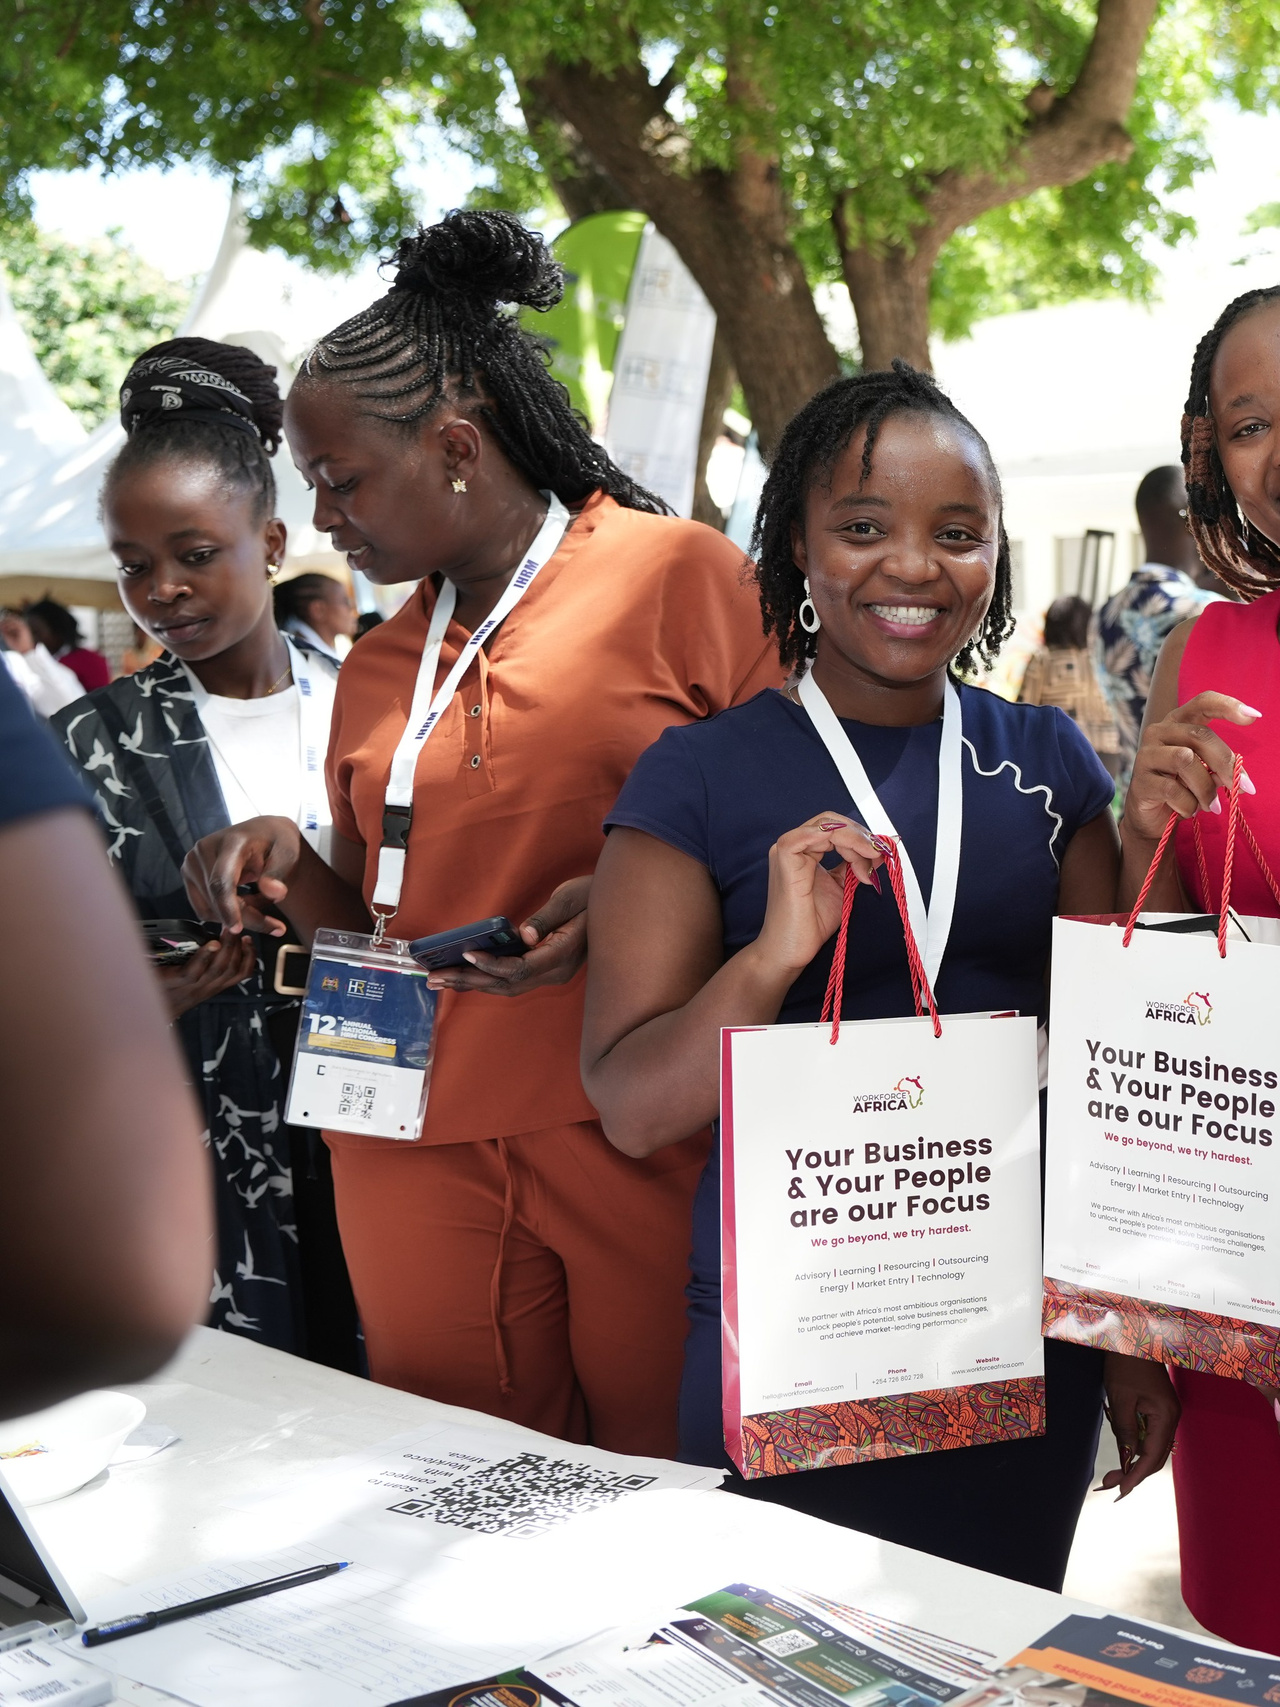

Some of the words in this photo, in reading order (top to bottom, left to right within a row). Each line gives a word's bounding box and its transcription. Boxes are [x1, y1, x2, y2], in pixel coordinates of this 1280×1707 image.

[513, 559, 539, 589] IHRM
[469, 620, 496, 645] IHRM
[414, 712, 438, 740] IHRM
[1144, 1007, 1197, 1026] AFRICA
[1145, 1000, 1196, 1014] WORKFORCE
[340, 1026, 378, 1036] NATIONAL
[341, 1020, 373, 1030] ANNUAL
[358, 1033, 397, 1045] CONGRESS
[1085, 1038, 1146, 1070] Your
[1153, 1049, 1278, 1090] Business
[852, 1091, 907, 1103] WORKFORCE
[852, 1098, 908, 1114] AFRICA
[1085, 1066, 1103, 1091] &
[1109, 1070, 1172, 1103] Your
[1180, 1082, 1276, 1121] People
[1087, 1099, 1130, 1123] are
[1136, 1108, 1183, 1133] our
[1191, 1112, 1273, 1147] Focus
[784, 1147, 855, 1171] Your
[863, 1135, 993, 1165] Business
[1103, 1131, 1120, 1143] We
[1120, 1135, 1134, 1147] go
[1135, 1136, 1175, 1154] beyond,
[1176, 1145, 1192, 1156] we
[1193, 1147, 1209, 1161] try
[1210, 1149, 1253, 1166] hardest.
[786, 1175, 807, 1200] &
[814, 1173, 885, 1197] Your
[893, 1161, 992, 1193] People
[1088, 1160, 1122, 1175] Advisory
[1126, 1167, 1161, 1183] Learning
[1166, 1174, 1212, 1193] Resourcing
[1217, 1183, 1269, 1203] Outsourcing
[1109, 1177, 1137, 1192] Energy
[1141, 1184, 1170, 1197] Market
[1170, 1189, 1191, 1203] Entry
[1197, 1194, 1245, 1213] Technology
[789, 1206, 839, 1228] are
[847, 1200, 898, 1223] our
[906, 1191, 991, 1217] Focus
[1090, 1202, 1102, 1210] We
[1101, 1204, 1126, 1215] partner
[1125, 1210, 1141, 1218] with
[1140, 1211, 1165, 1223] Africa's
[1164, 1218, 1183, 1227] most
[1183, 1220, 1218, 1233] ambitious
[1217, 1227, 1266, 1242] organisations
[810, 1238, 828, 1247] We
[830, 1236, 845, 1248] go
[847, 1230, 891, 1245] beyond,
[891, 1231, 909, 1239] we
[910, 1228, 926, 1239] try
[927, 1223, 972, 1236] hardest.
[794, 1272, 832, 1281] Advisory
[838, 1265, 876, 1277] Learning
[882, 1259, 931, 1272] Resourcing
[937, 1253, 989, 1266] Outsourcing
[819, 1283, 849, 1294] Energy
[856, 1278, 887, 1289] Market
[887, 1277, 910, 1286] Entry
[916, 1271, 966, 1283] Technology
[810, 1312, 838, 1323] partner
[838, 1310, 855, 1318] with
[855, 1307, 883, 1316] Africa's
[882, 1305, 902, 1313] most
[902, 1300, 939, 1311] ambitious
[939, 1295, 988, 1308] organisations
[1250, 1296, 1276, 1307] Website
[805, 1322, 831, 1333] unlock
[831, 1318, 862, 1331] people's
[861, 1314, 896, 1327] potential,
[896, 1313, 916, 1322] solve
[916, 1310, 948, 1319] business
[948, 1305, 989, 1316] challenges,
[818, 1332, 835, 1341] and
[834, 1328, 864, 1339] achieve
[864, 1321, 921, 1335] market-leading
[921, 1317, 968, 1330] performance
[950, 1361, 1025, 1375] www.workforceafrica.com
[793, 1380, 813, 1388] Email
[403, 1453, 471, 1472] Workforce
[424, 1467, 454, 1478] with
[380, 1470, 437, 1485] connect
[383, 1482, 419, 1493] Scan
